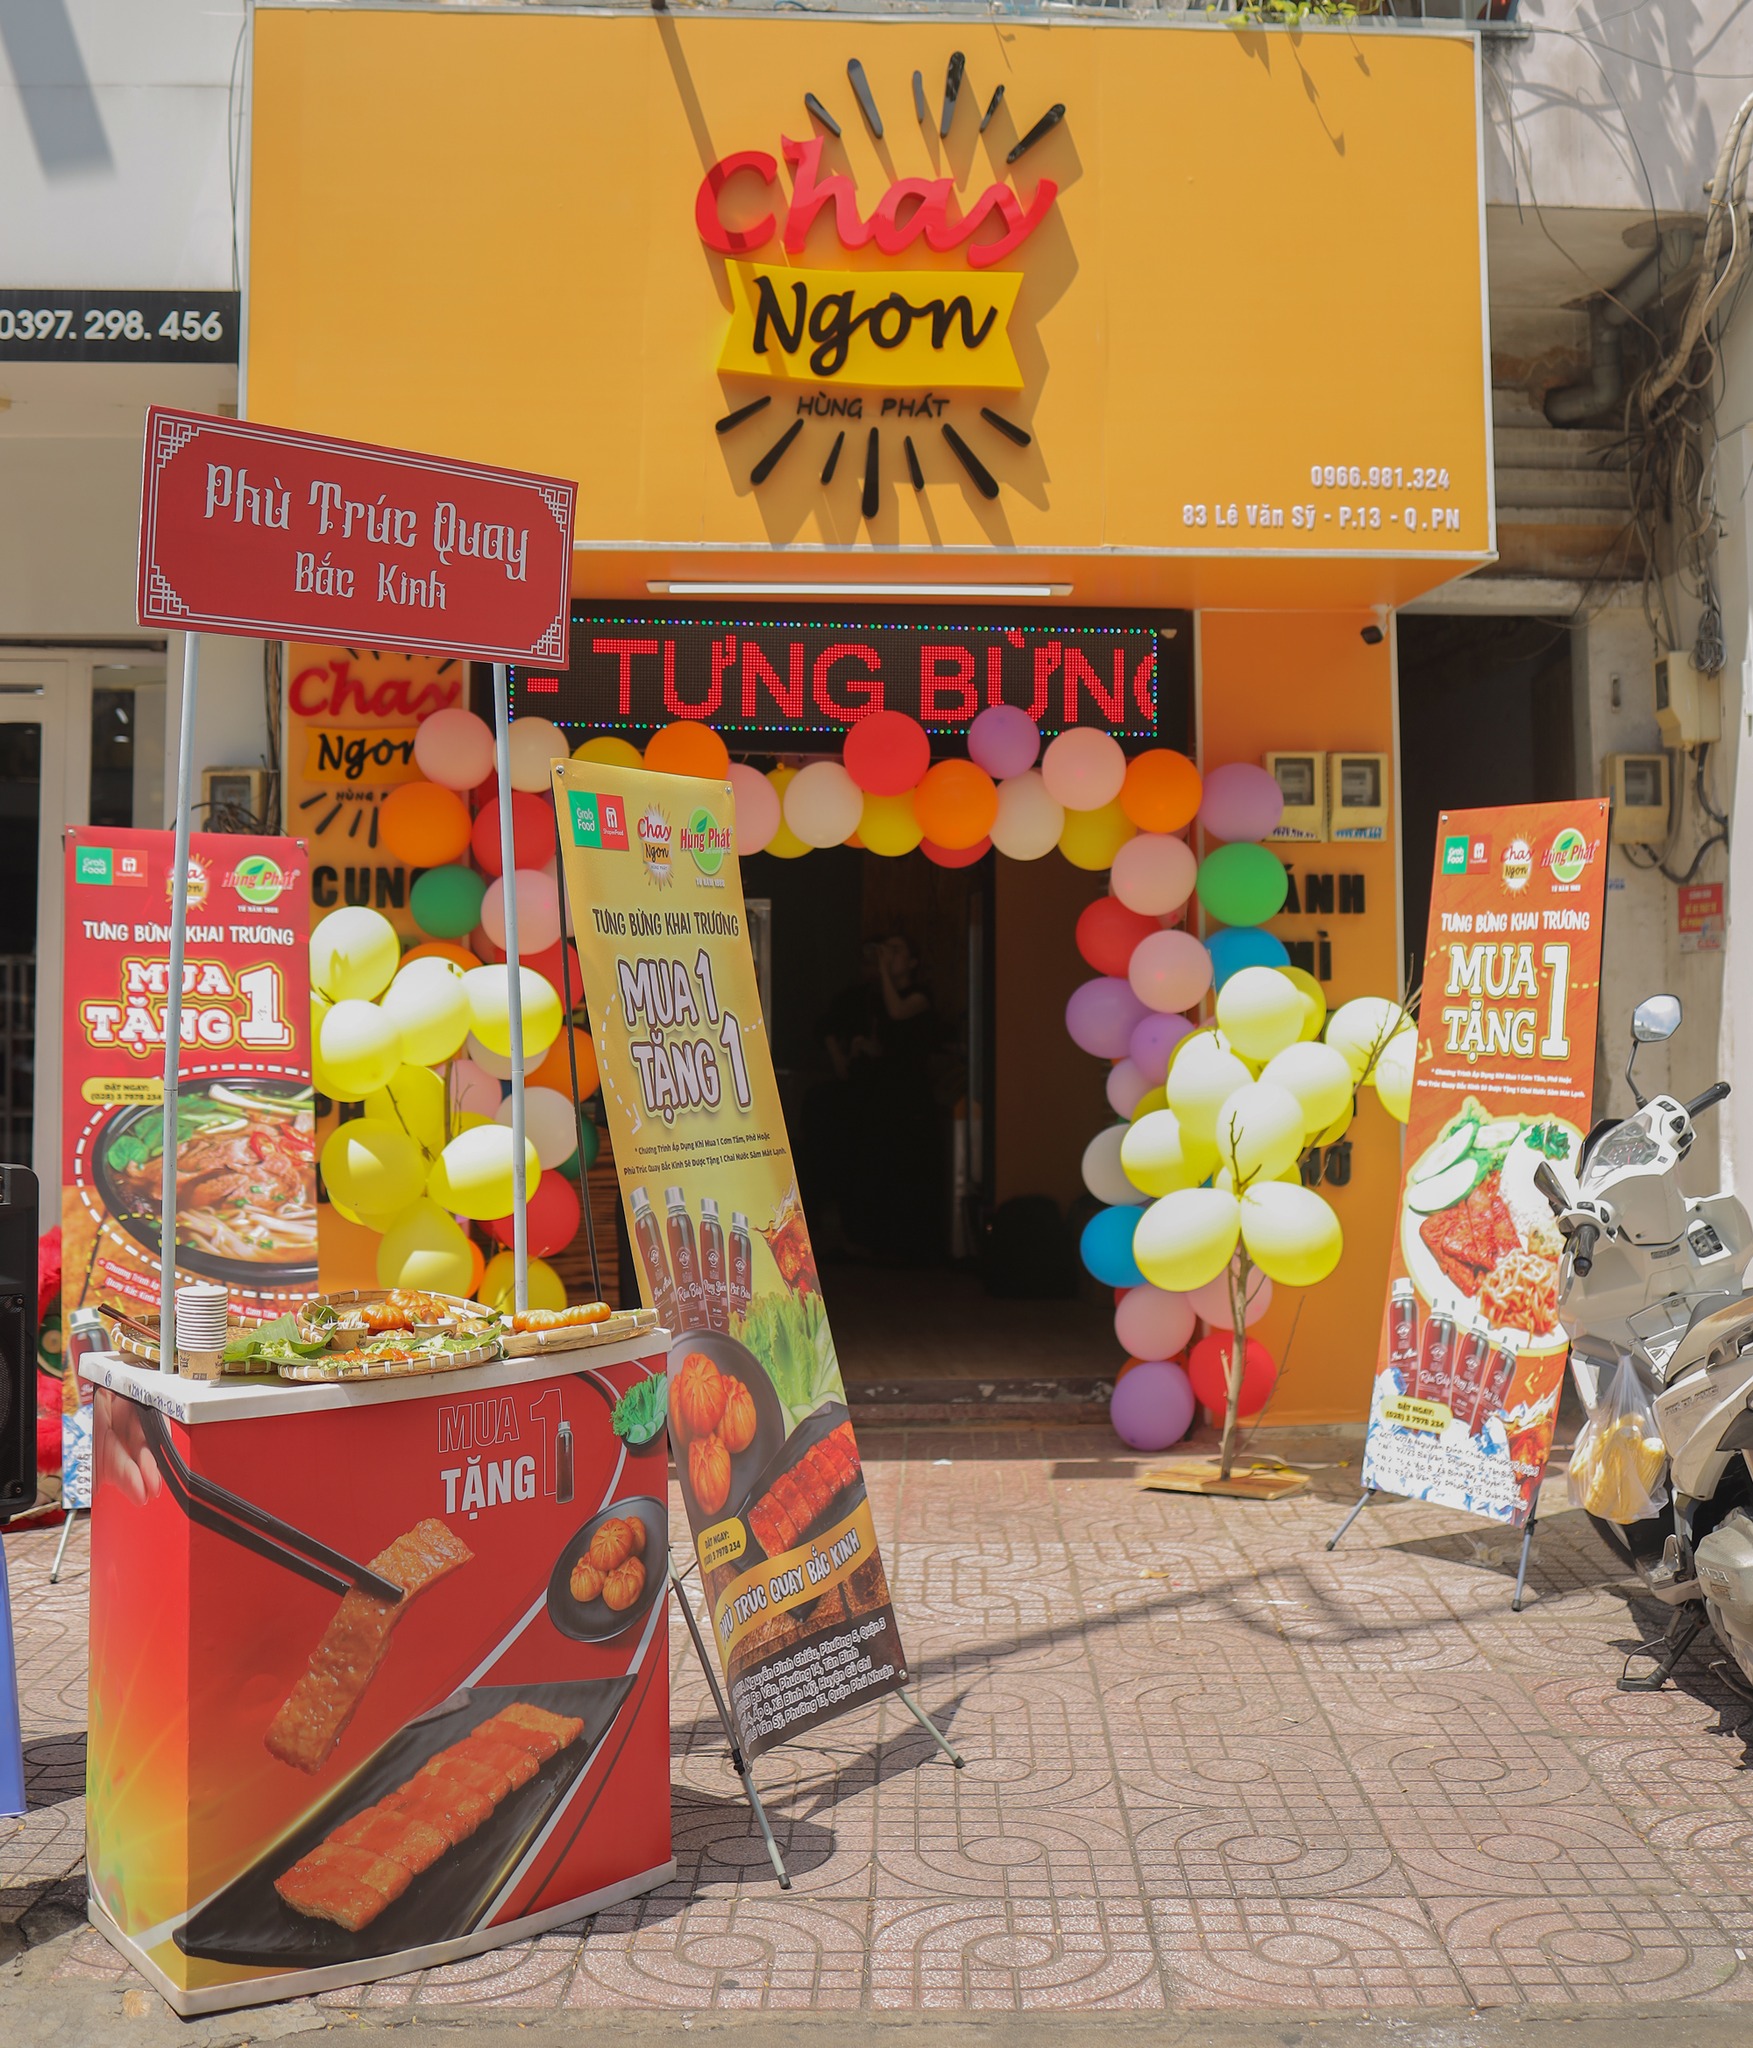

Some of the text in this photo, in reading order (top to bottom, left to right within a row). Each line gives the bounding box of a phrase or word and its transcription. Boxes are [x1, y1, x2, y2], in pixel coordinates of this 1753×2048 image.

[695, 133, 1059, 269] Chay
[0, 309, 223, 342] 0397. 298. 456
[752, 275, 998, 376] Ngon
[796, 391, 950, 419] HÙNG PHÁT
[1311, 465, 1450, 490] 0966.981.324
[204, 462, 530, 582] Phù Trúc Quay
[1182, 504, 1207, 527] 83
[1215, 503, 1239, 527] Lê
[1246, 503, 1284, 528] Văn
[1291, 505, 1316, 530] Sỹ
[1339, 507, 1381, 528] P.13
[294, 551, 447, 611] Bắc Kinh
[288, 659, 461, 724] Chay
[592, 634, 885, 723] TƯNG
[576, 806, 594, 821] Grab
[577, 818, 595, 832] Food
[637, 815, 672, 842] Chay
[644, 842, 670, 863] Ngon
[680, 827, 731, 853] Hùng Phát
[1501, 845, 1535, 862] Chay
[1540, 848, 1568, 868] Hùng
[221, 870, 256, 889] Hùng
[312, 866, 437, 908] CUN
[1278, 864, 1366, 914] ÁNH
[1504, 865, 1529, 879] Ngon
[83, 920, 129, 942] TƯNG
[185, 925, 224, 943] KHAI
[229, 924, 294, 946] TRƯƠNG
[592, 908, 740, 937] TƯNG BỪNG KHAI TRƯƠNG
[1441, 908, 1590, 933] TƯNG BỪNG KHAI TRƯƠNG
[127, 962, 290, 1045] MUA 1
[618, 948, 720, 1029] MUA 1
[1447, 945, 1570, 1058] MUA 1
[85, 996, 233, 1052] TẶNG
[1443, 1000, 1535, 1062] TẶNG
[631, 1011, 751, 1124] TẶNG 1
[671, 1141, 679, 1153] Áp
[705, 1138, 716, 1147] Mua
[671, 1160, 684, 1169] Kinh
[723, 1153, 735, 1162] Chai
[438, 1388, 563, 1496] MUA 1
[440, 1454, 536, 1521] TẶNG
[729, 1540, 741, 1553] 234
[733, 1584, 768, 1625] TRÚC
[769, 1565, 805, 1603] QUAY
[807, 1545, 831, 1584] BẮC
[830, 1528, 861, 1571] KINH
[773, 1657, 795, 1678] Đình
[819, 1632, 852, 1657] Phường
[859, 1620, 880, 1641] Quận
[878, 1616, 887, 1630] 3
[751, 1690, 761, 1706] Ba
[778, 1664, 812, 1692] Phường
[822, 1656, 840, 1672] Tân
[838, 1646, 860, 1666] Bình
[783, 1685, 804, 1706] Bình
[818, 1668, 846, 1691] Huyện
[844, 1662, 857, 1679] Củ
[855, 1655, 873, 1675] Chi
[784, 1695, 818, 1723] Phường
[827, 1684, 851, 1704] Quận
[850, 1676, 868, 1694] Phú
[867, 1664, 895, 1686] Nhuận
